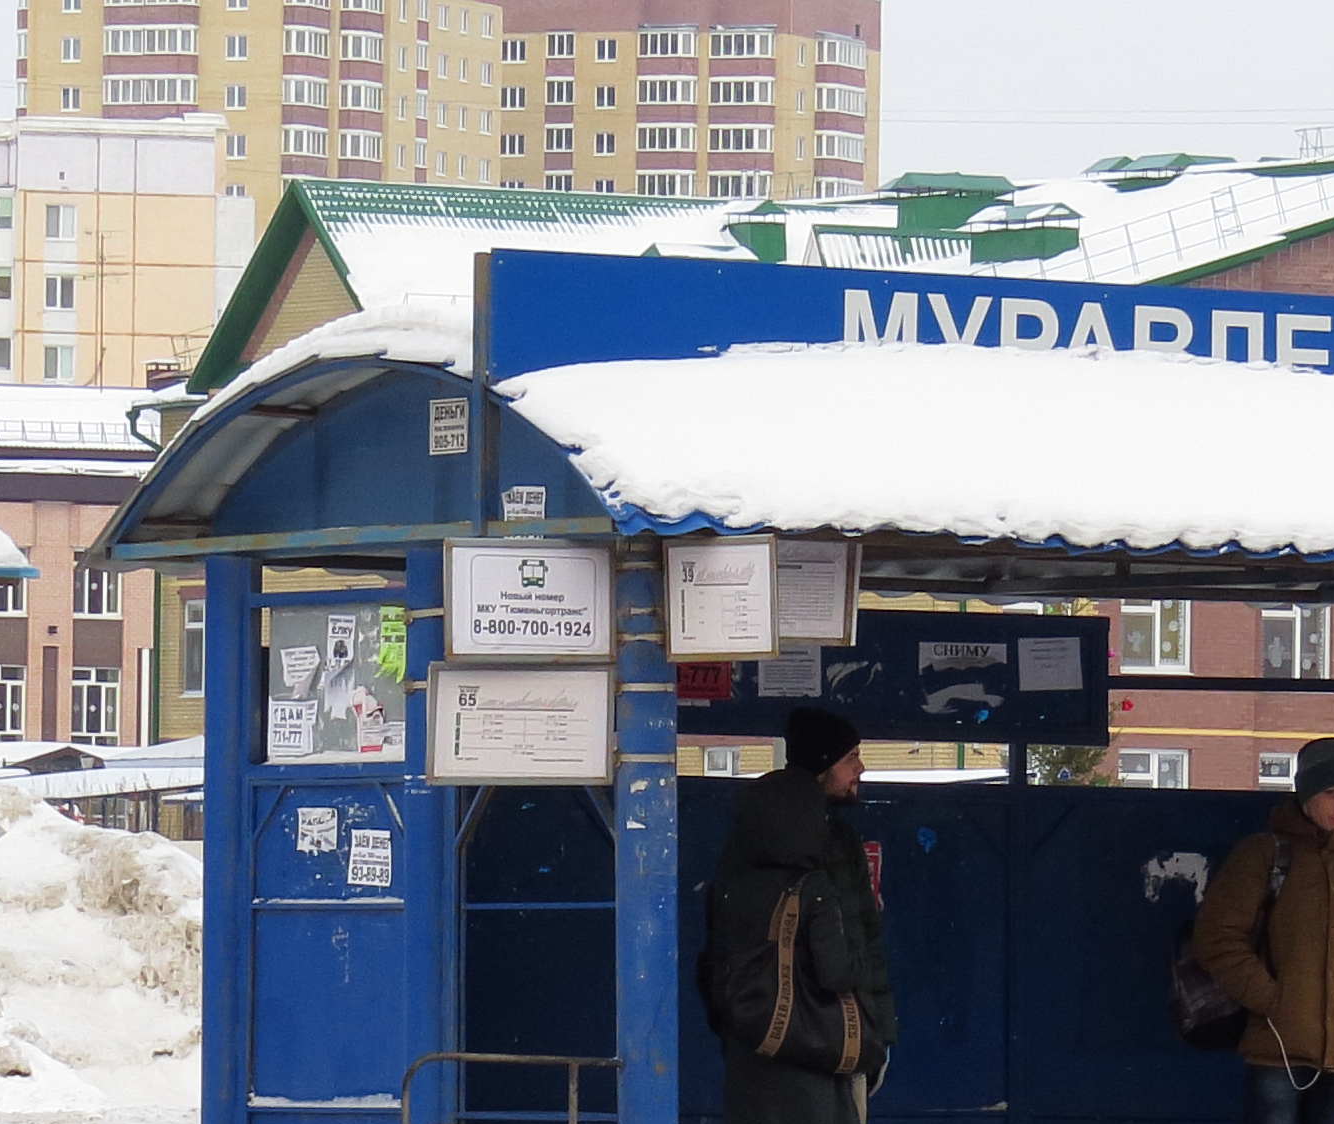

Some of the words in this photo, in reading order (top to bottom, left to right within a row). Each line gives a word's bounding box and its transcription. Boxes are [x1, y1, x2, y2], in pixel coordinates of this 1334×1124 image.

[434, 404, 465, 422] ДЕНЬГИ
[500, 591, 532, 601] Новый
[534, 593, 564, 603] номер
[477, 604, 497, 613] МКУ
[473, 619, 592, 637] 8-800-700-1924
[933, 643, 990, 659] СНИМУ
[458, 693, 477, 707] 65
[768, 1001, 790, 1040] DAVID
[780, 964, 792, 1002] JONES
[842, 999, 858, 1038] JONES
